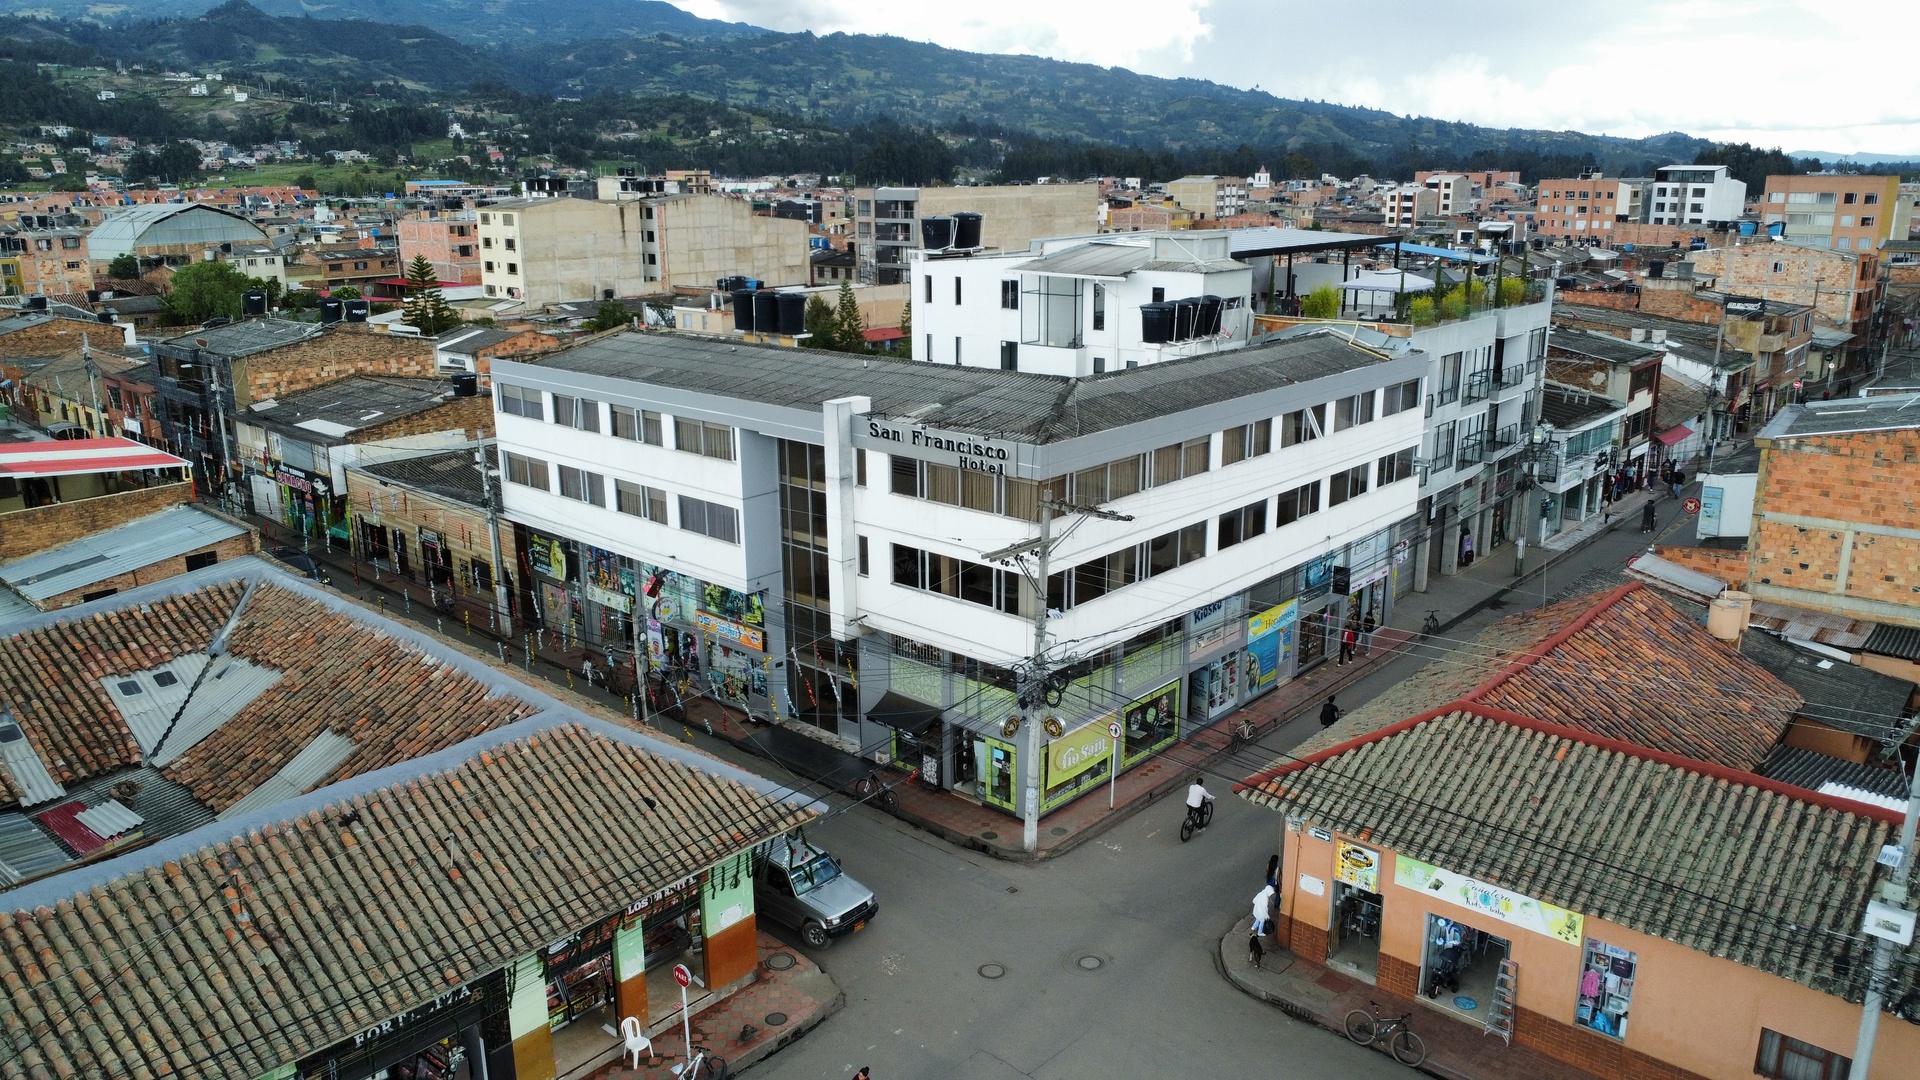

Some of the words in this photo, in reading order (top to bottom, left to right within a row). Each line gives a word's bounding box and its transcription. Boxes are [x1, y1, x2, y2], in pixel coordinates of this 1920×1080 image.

[869, 421, 904, 442] San
[911, 430, 1010, 460] Francisco
[959, 455, 1007, 476] Hotel
[275, 469, 312, 494] CAMACHO
[627, 898, 649, 915] LOS
[675, 970, 688, 983] PARE
